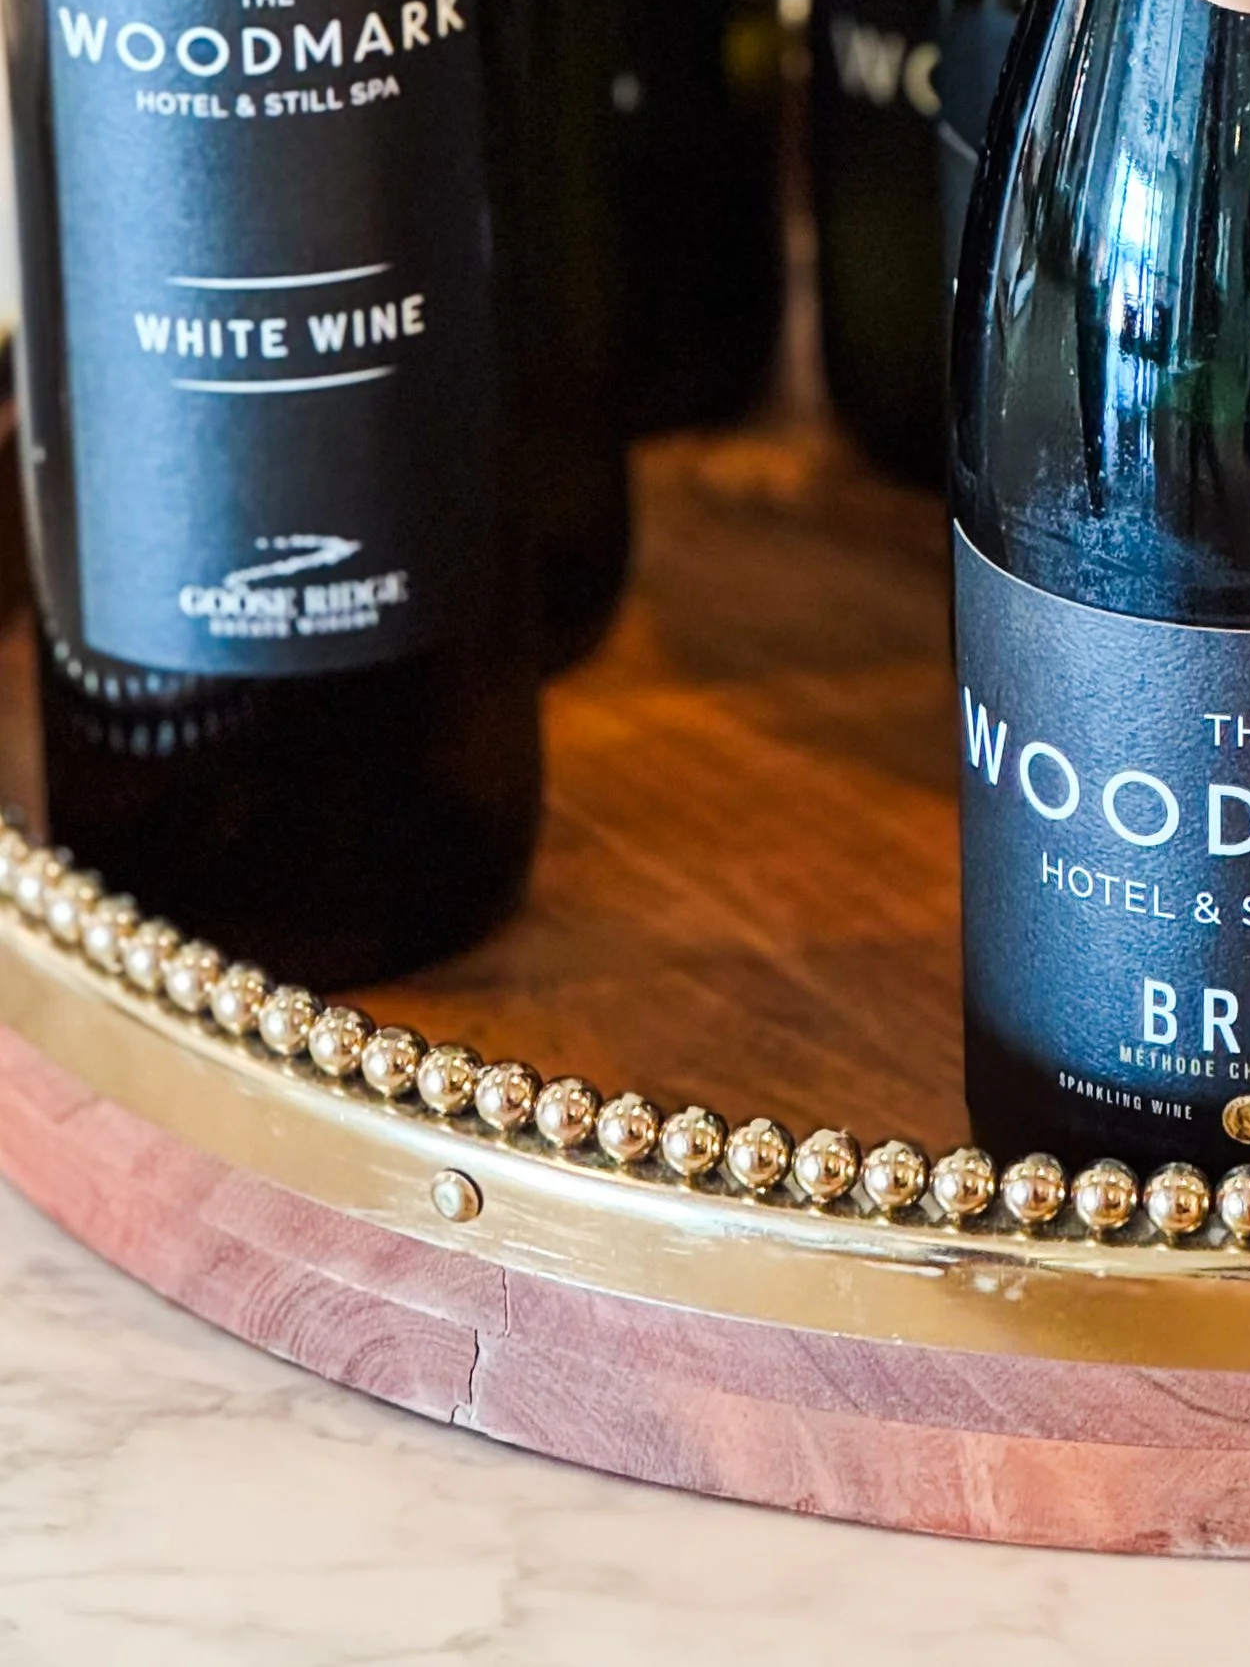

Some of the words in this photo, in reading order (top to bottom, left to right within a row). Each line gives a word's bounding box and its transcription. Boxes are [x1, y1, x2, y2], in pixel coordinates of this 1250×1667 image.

[136, 90, 229, 119] HOTEL
[234, 93, 257, 119] &
[263, 87, 343, 117] STILL
[350, 75, 401, 106] SPA
[134, 311, 288, 359] WHITE
[308, 293, 426, 354] WINE
[1041, 851, 1176, 919] HOTEL
[1193, 891, 1222, 926] &
[1058, 1071, 1143, 1111] SPARKLING
[1151, 1098, 1193, 1121] WINE
